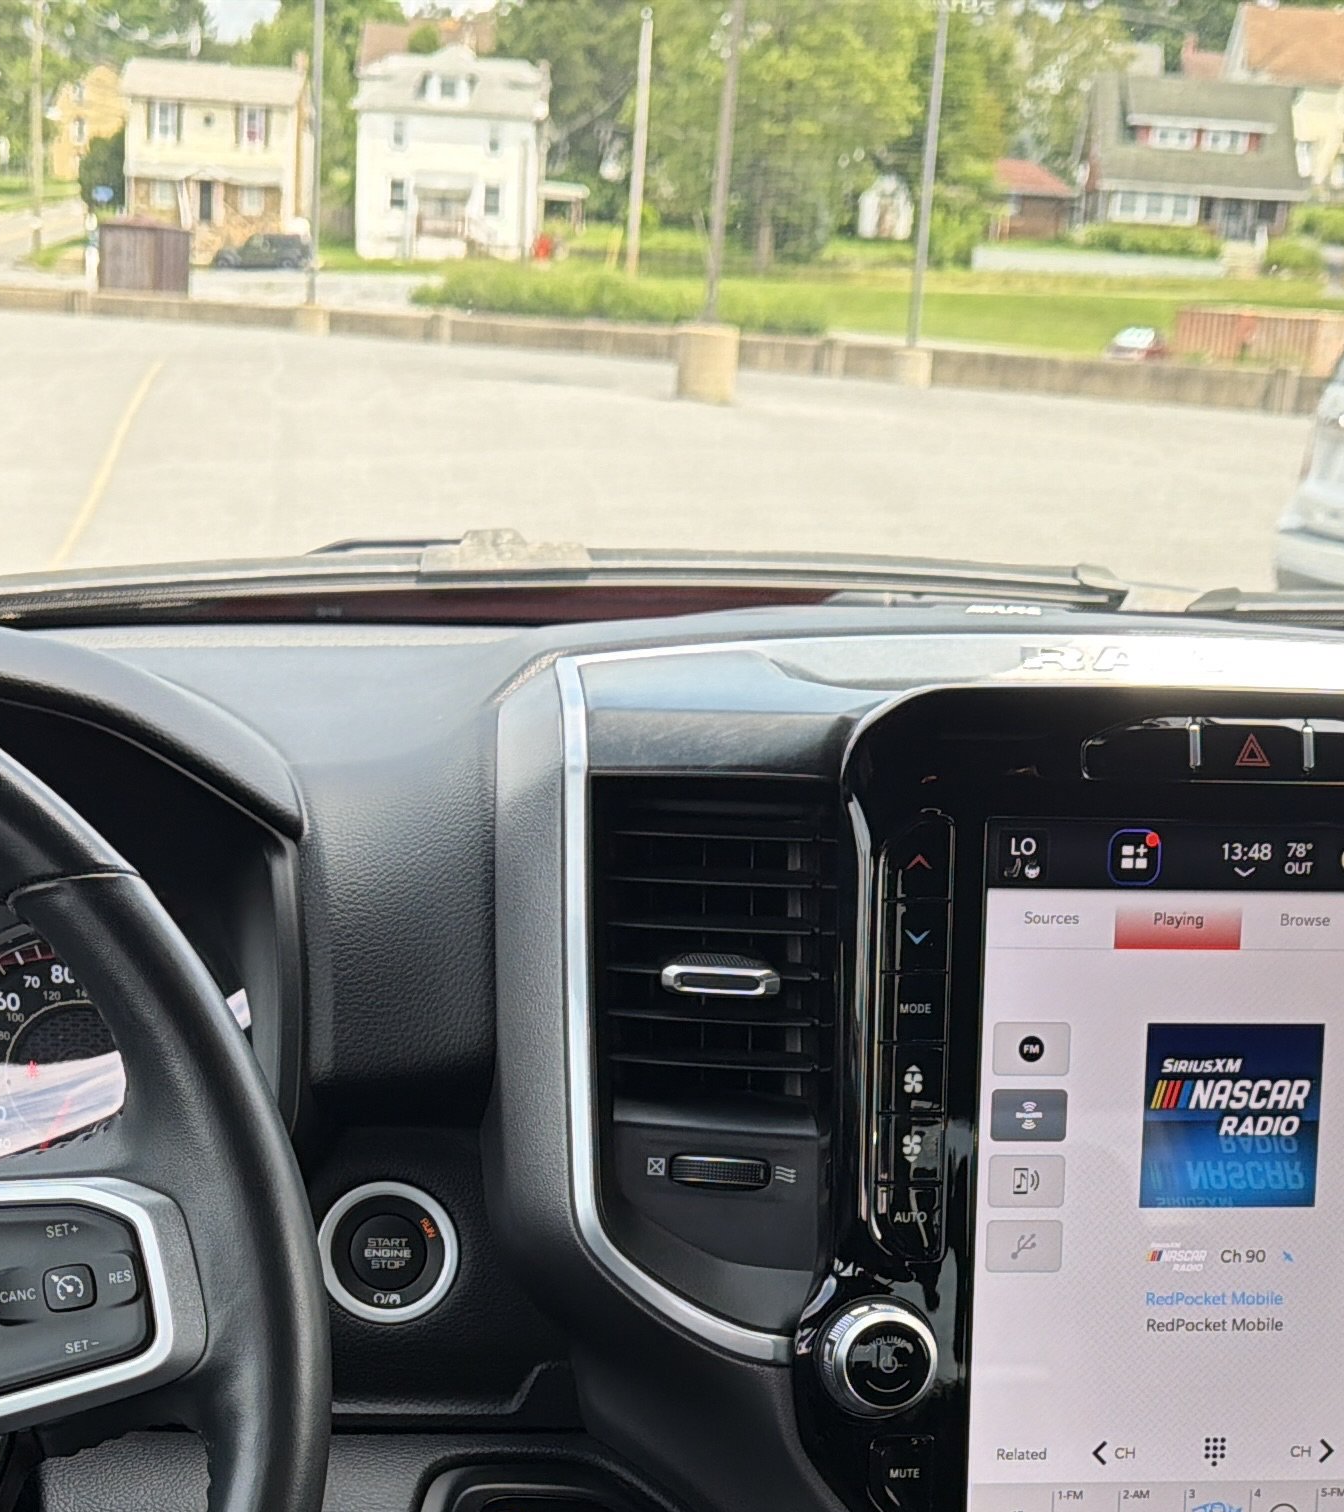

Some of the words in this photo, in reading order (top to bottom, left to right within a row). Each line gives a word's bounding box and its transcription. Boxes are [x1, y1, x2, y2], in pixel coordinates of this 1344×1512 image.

[1011, 838, 1036, 855] LO
[1222, 842, 1272, 861] 13:48
[1284, 861, 1313, 875] OUT
[1024, 911, 1079, 926] Sources
[1153, 911, 1204, 929] Playing
[1280, 913, 1331, 928] Browse
[23, 975, 41, 991] 70
[43, 991, 61, 1001] 120
[900, 1003, 931, 1014] MODE
[6, 1013, 25, 1023] 100
[1023, 1043, 1041, 1055] FM
[1188, 1079, 1312, 1110] NASCAR
[1218, 1115, 1301, 1136] RADIO
[894, 1211, 928, 1224] AUTO
[419, 1217, 438, 1240] RUN
[367, 1238, 408, 1247] START
[364, 1249, 412, 1259] ENGINE
[1220, 1249, 1242, 1263] Ch
[1246, 1249, 1266, 1263] 90
[370, 1260, 406, 1270] STOP
[108, 1269, 132, 1285] RES
[0, 1287, 37, 1304] CANC
[1145, 1291, 1228, 1306] RedPocket
[1231, 1291, 1284, 1306] Mobile
[1146, 1318, 1228, 1332] RedPocket
[1231, 1318, 1284, 1332] Mobile
[996, 1448, 1047, 1461] Related
[1114, 1447, 1136, 1460] CH
[1290, 1445, 1312, 1457] CH
[889, 1468, 920, 1479] MUTE
[1058, 1489, 1084, 1500] 1-FM
[1123, 1489, 1150, 1499] 2-AM
[1189, 1489, 1196, 1499] 3
[1254, 1488, 1261, 1498] 4
